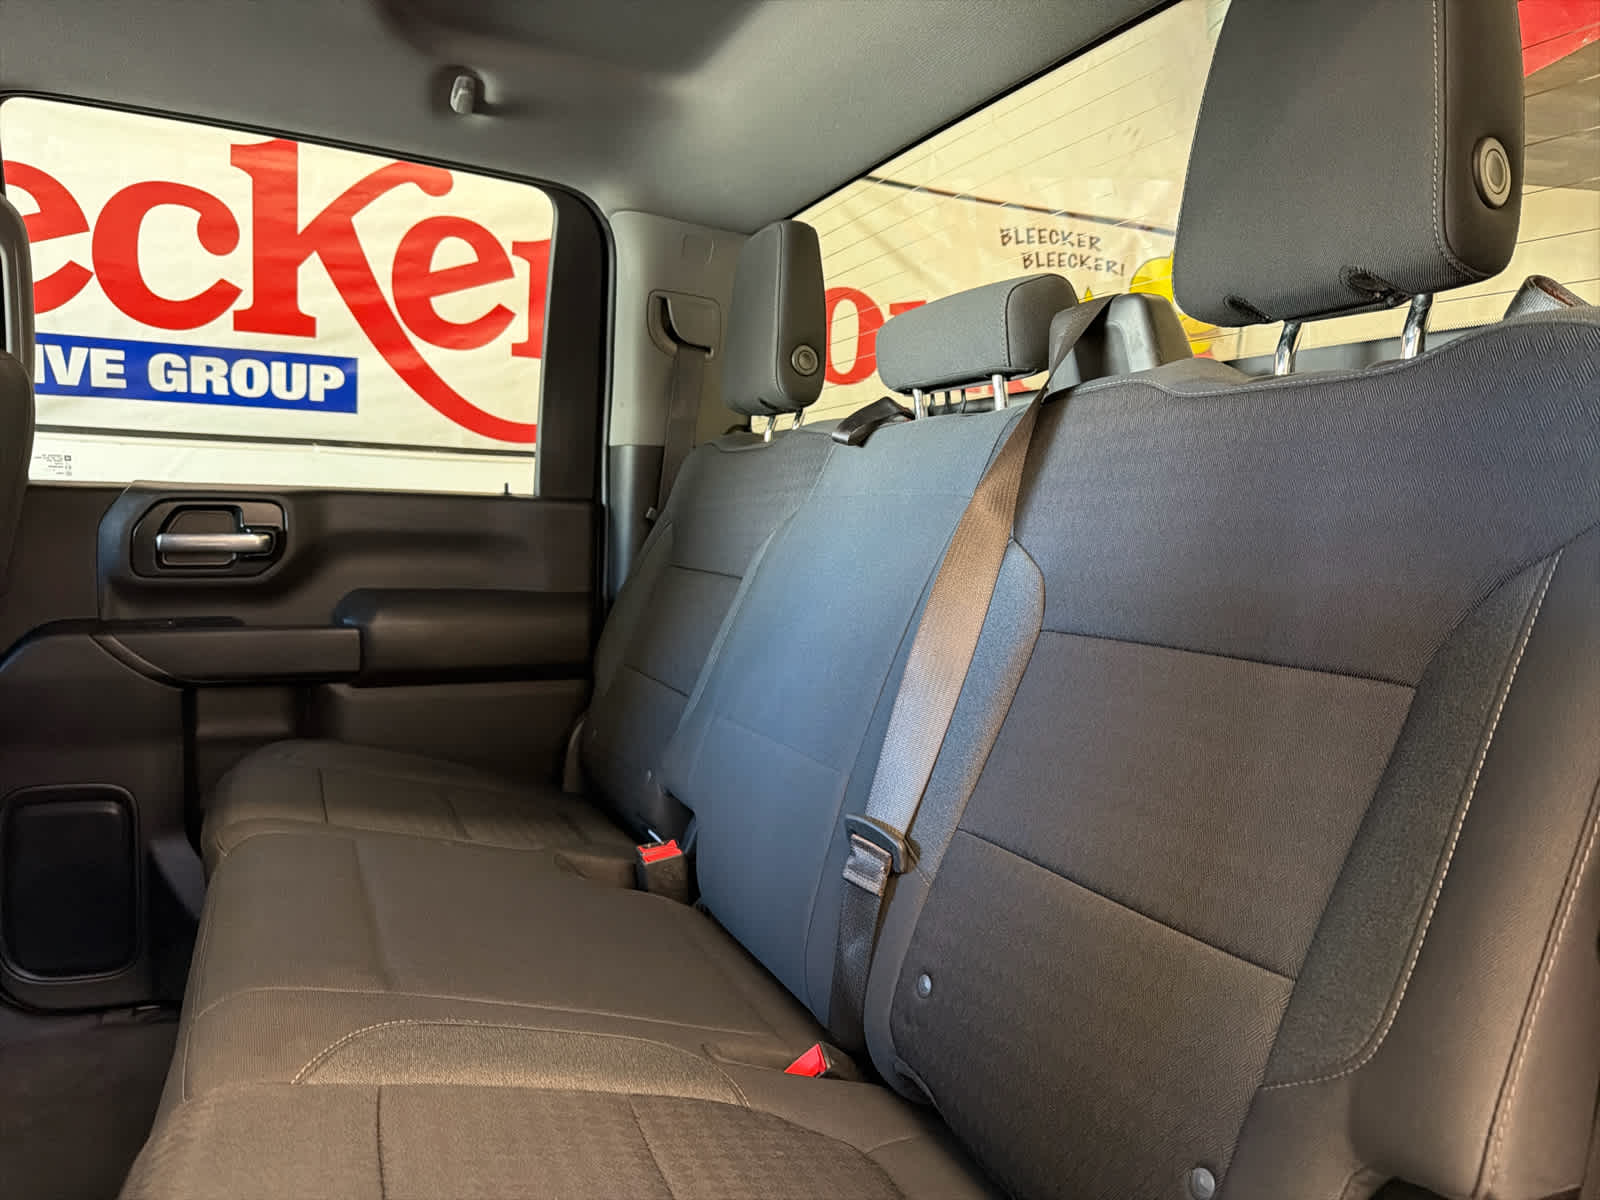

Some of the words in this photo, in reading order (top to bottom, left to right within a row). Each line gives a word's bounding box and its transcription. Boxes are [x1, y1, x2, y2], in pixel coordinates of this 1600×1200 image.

[999, 226, 1102, 252] BLEECKER
[1022, 251, 1126, 277] BLEECKER!
[148, 353, 345, 402] GROUP
